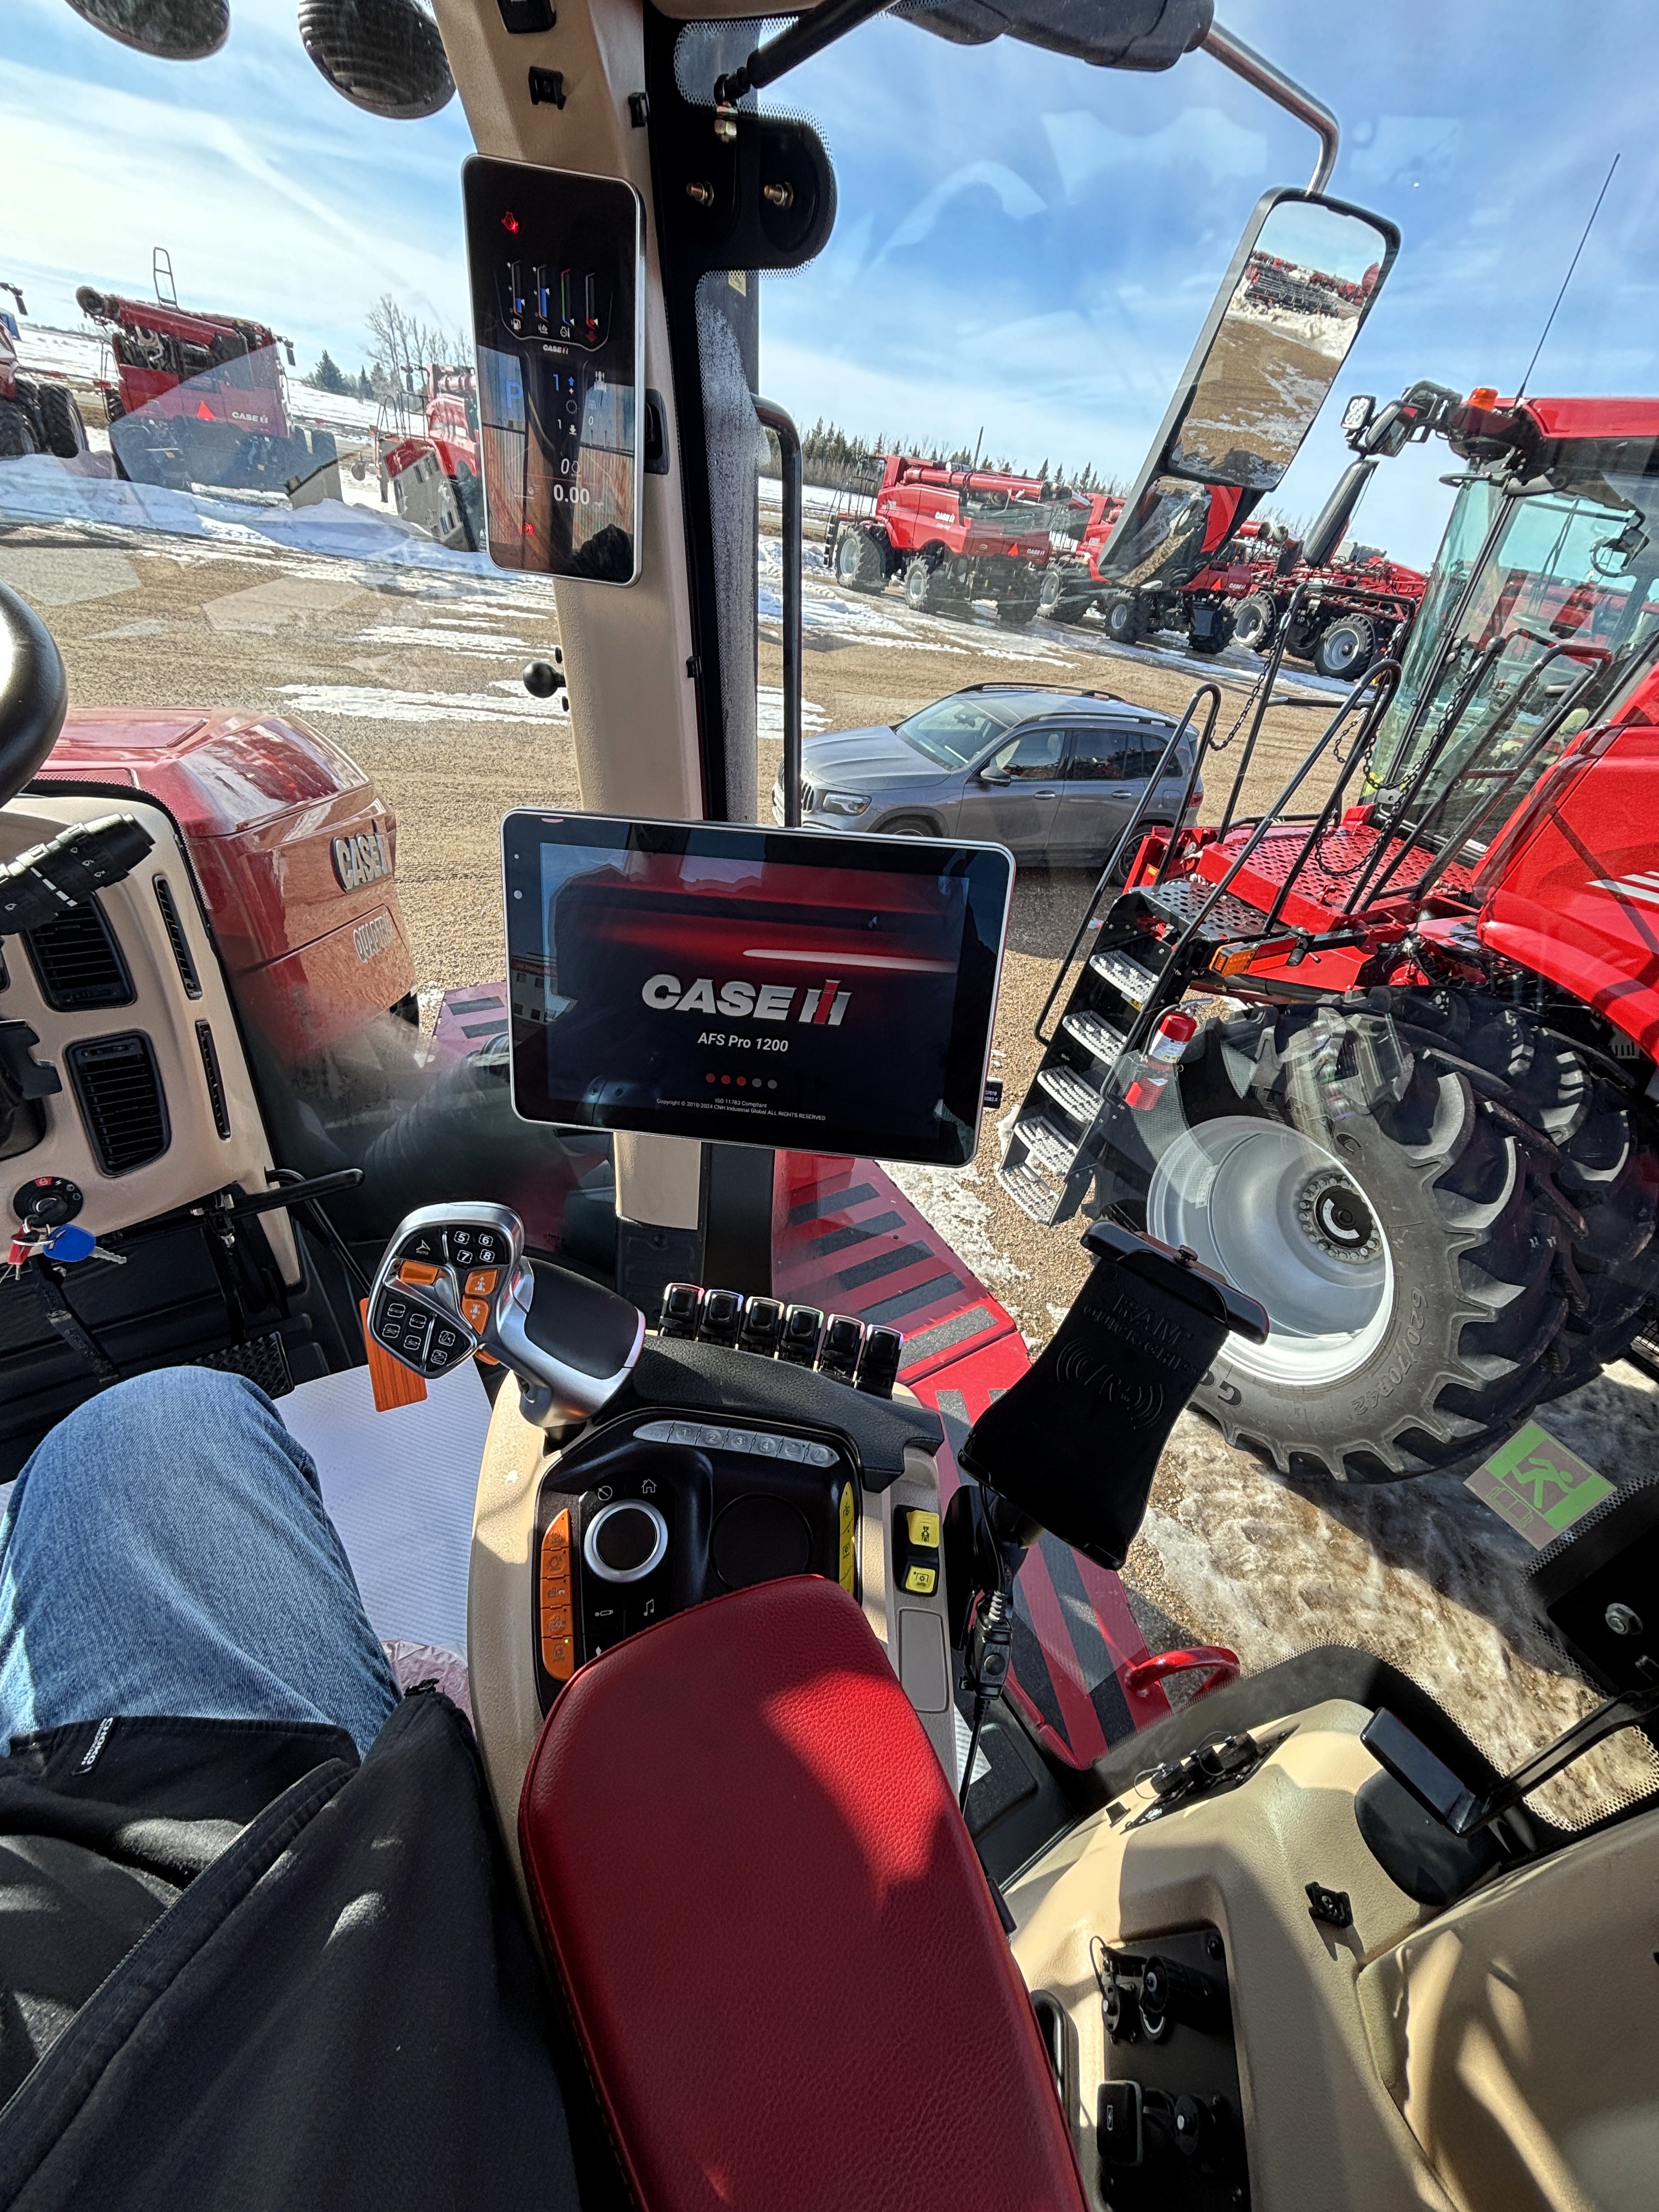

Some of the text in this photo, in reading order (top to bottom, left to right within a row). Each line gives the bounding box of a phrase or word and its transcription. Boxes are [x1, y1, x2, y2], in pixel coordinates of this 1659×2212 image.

[543, 344, 562, 353] CASE
[506, 380, 523, 408] P
[232, 411, 259, 422] CASE
[561, 458, 570, 475] 0
[554, 484, 590, 505] 0.00
[935, 511, 950, 522] CASE
[336, 835, 382, 890] CASE
[641, 973, 797, 1021] CASE
[697, 1032, 789, 1052] AFS Pro 1200
[657, 1098, 680, 1106] Copyright
[726, 1105, 749, 1113] Industrial
[798, 1113, 826, 1121] RESERVED
[458, 1233, 466, 1242] 5
[482, 1236, 490, 1245] 6
[461, 1252, 470, 1261] 7
[483, 1251, 492, 1261] 8
[709, 1434, 716, 1443] 2
[736, 1437, 743, 1445] 3
[762, 1442, 769, 1451] 4
